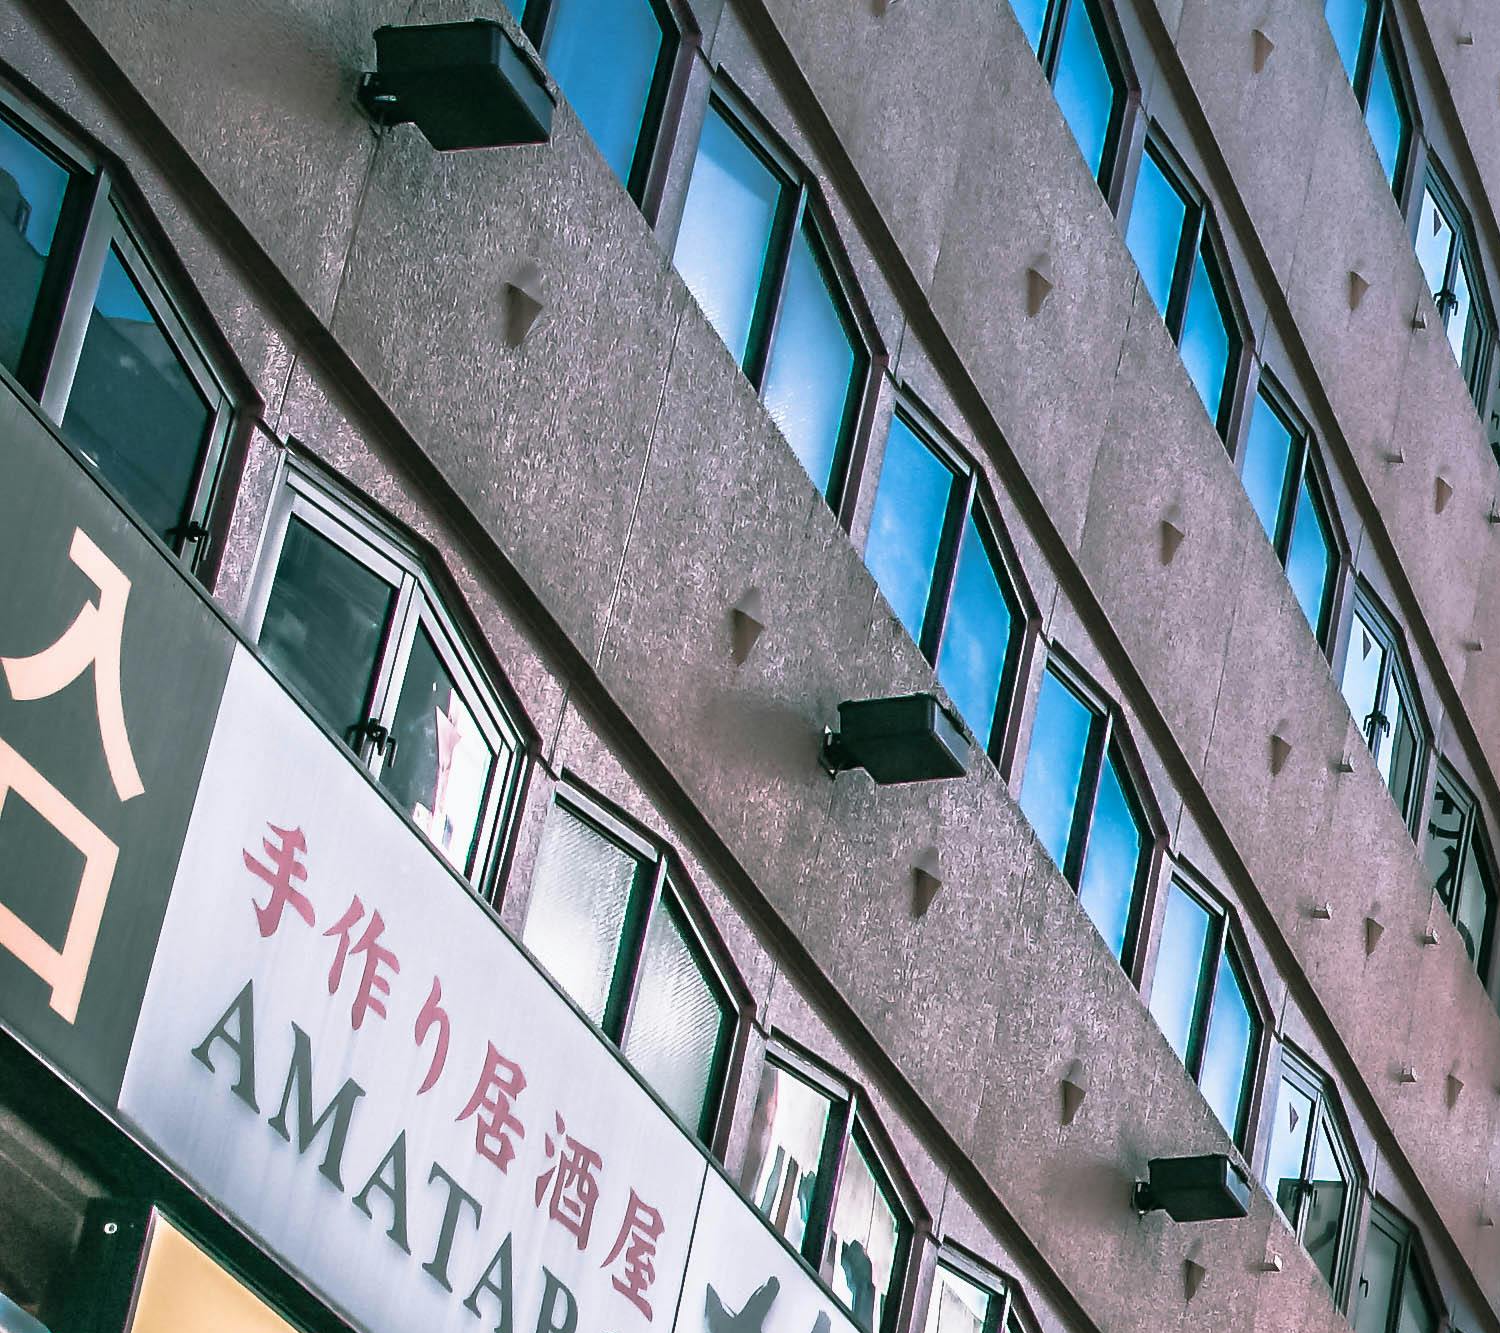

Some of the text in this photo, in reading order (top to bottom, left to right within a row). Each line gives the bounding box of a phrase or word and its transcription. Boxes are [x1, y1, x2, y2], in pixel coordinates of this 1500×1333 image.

[242, 822, 666, 1322] 手作り居酒屋
